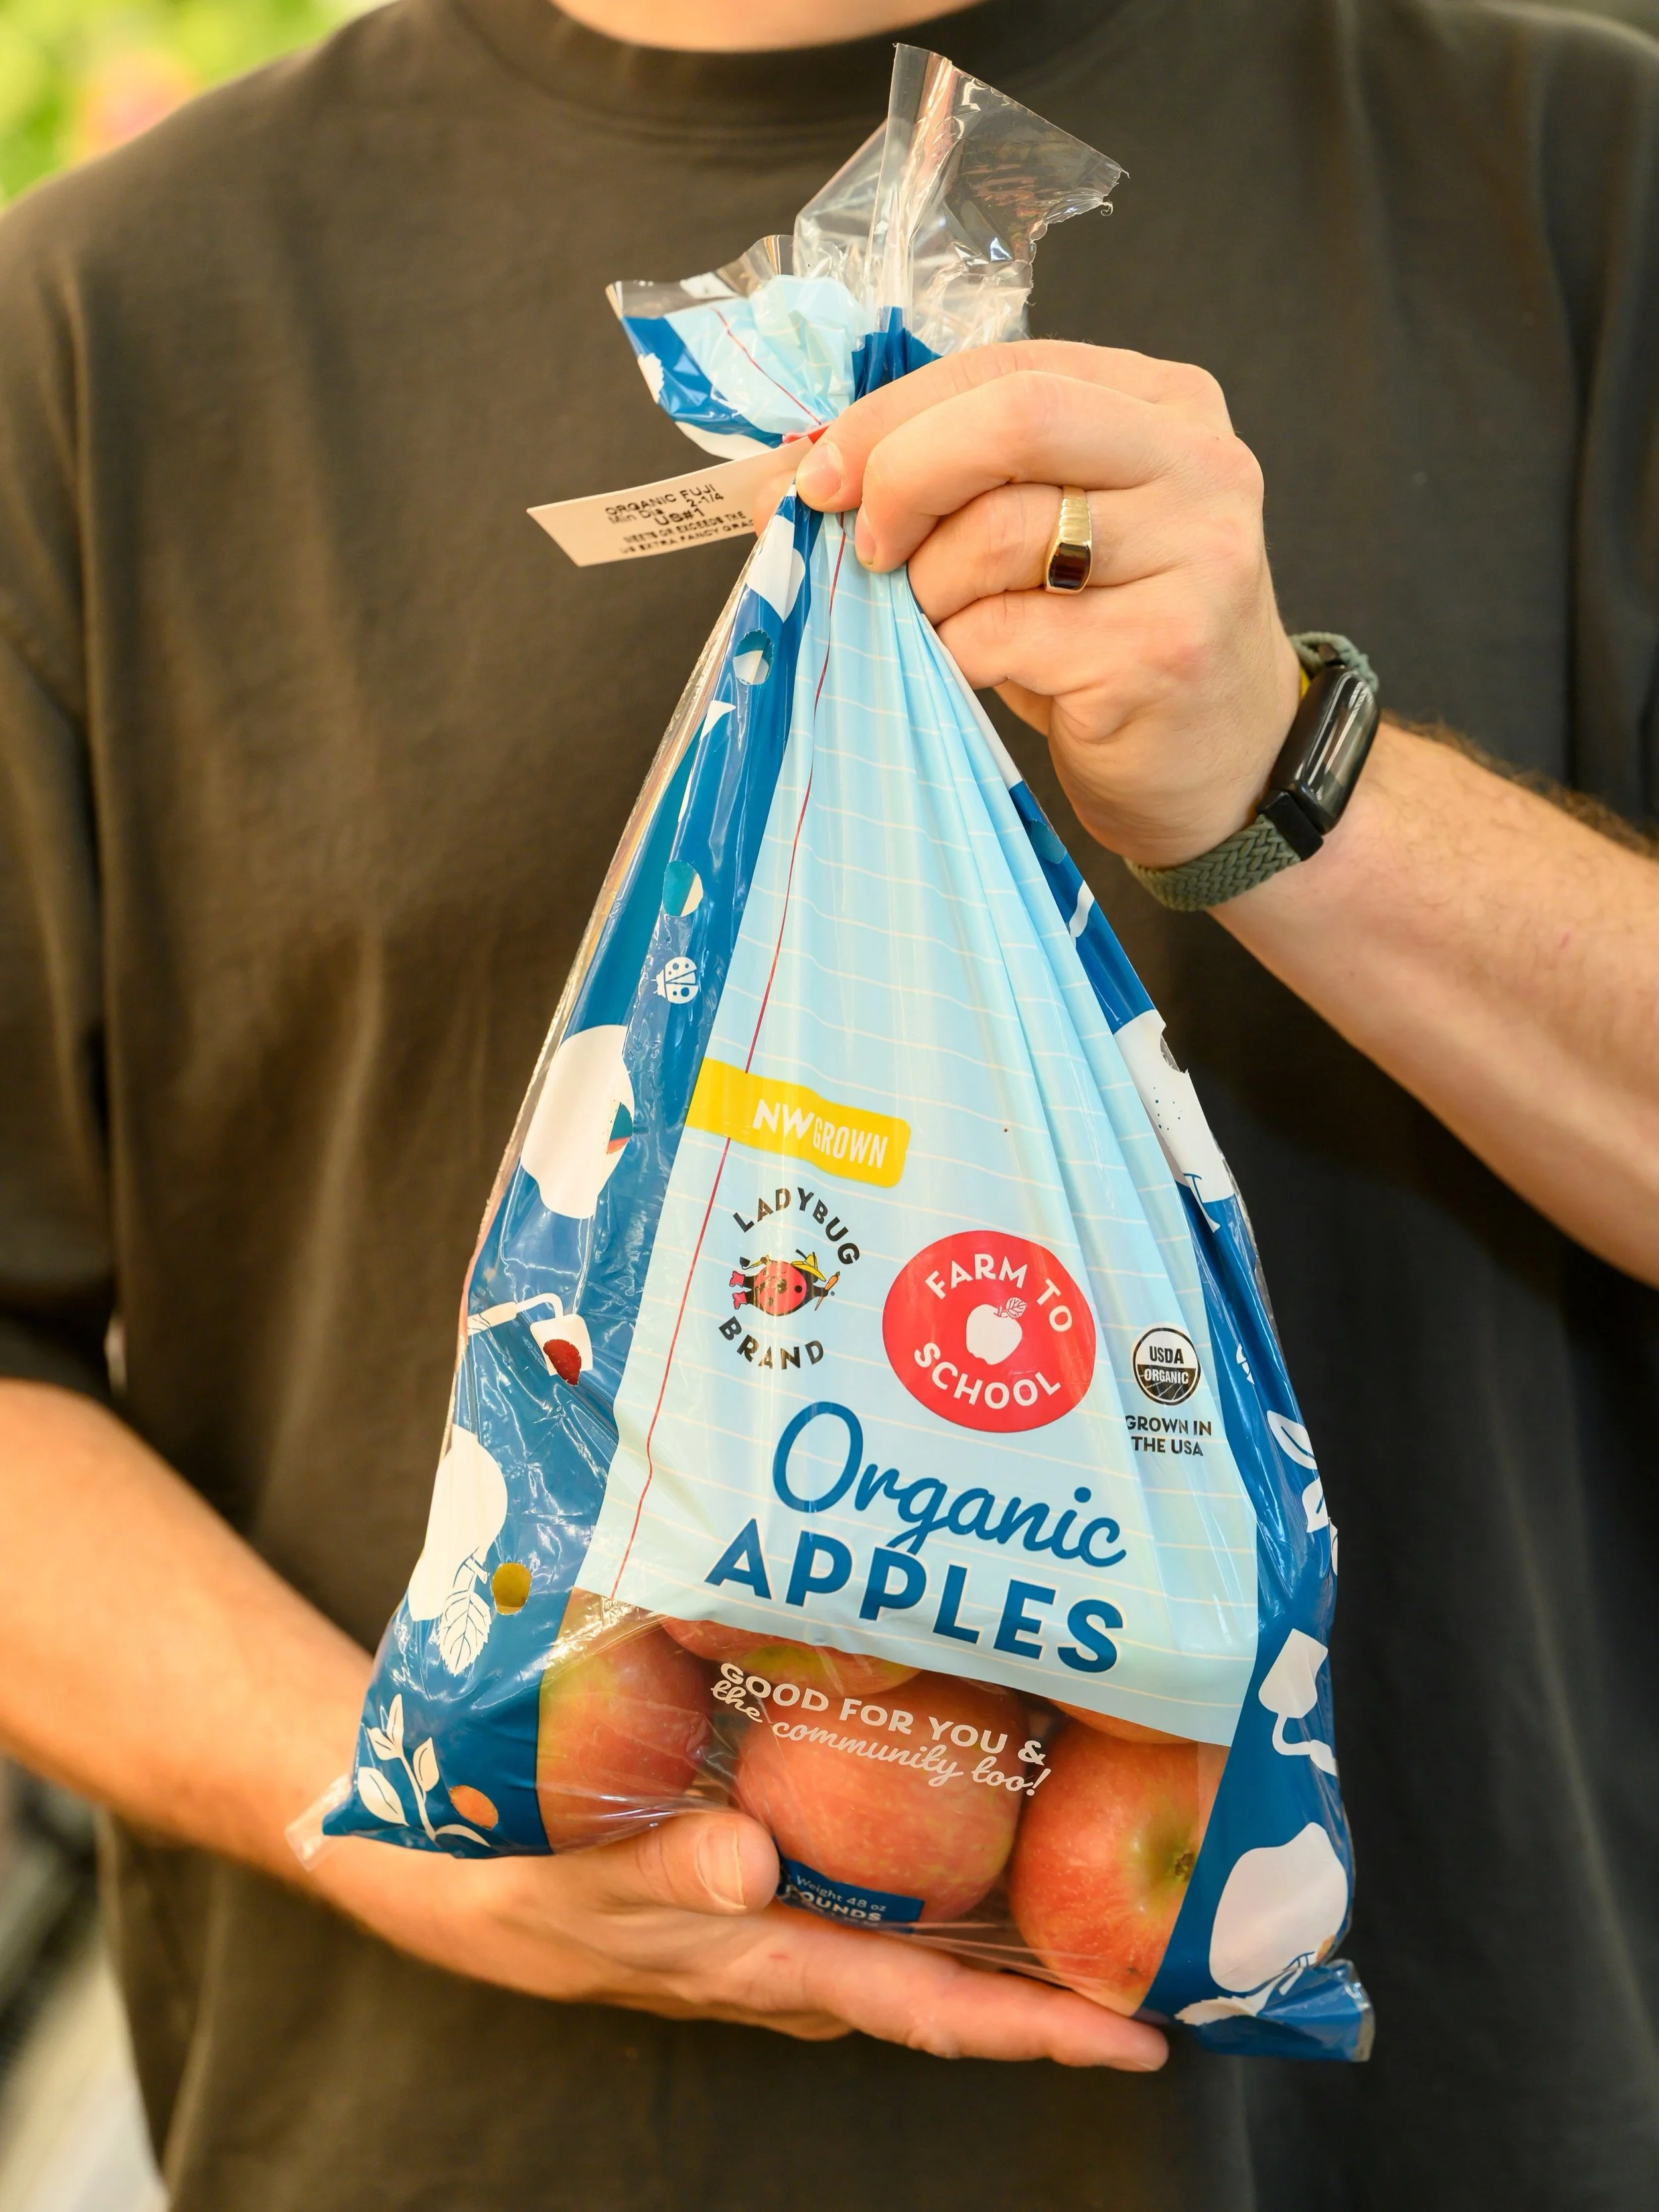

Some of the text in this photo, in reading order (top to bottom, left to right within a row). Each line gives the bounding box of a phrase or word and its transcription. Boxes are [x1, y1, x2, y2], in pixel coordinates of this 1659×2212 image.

[605, 484, 716, 516] ORGANIC FUJI
[686, 493, 724, 508] 2-1/4
[753, 1099, 888, 1168] NW GROWN
[733, 1186, 860, 1265] LADYBUG
[925, 1253, 1073, 1333] FARM TO
[718, 1316, 824, 1370] BRAND
[1149, 1345, 1185, 1365] USDA
[914, 1342, 1061, 1410] SCHOOL
[1143, 1368, 1190, 1385] ORGANIC
[1125, 1415, 1212, 1436] GROWN IN
[1131, 1436, 1204, 1457] THE USA
[772, 1401, 1127, 1568] Organic
[703, 1517, 1125, 1673] APPLES
[711, 1681, 1052, 1797] the community too!
[720, 1663, 1047, 1766] GOOD FOR YOU &
[796, 1874, 844, 1903] Weight
[846, 1897, 868, 1909] 48
